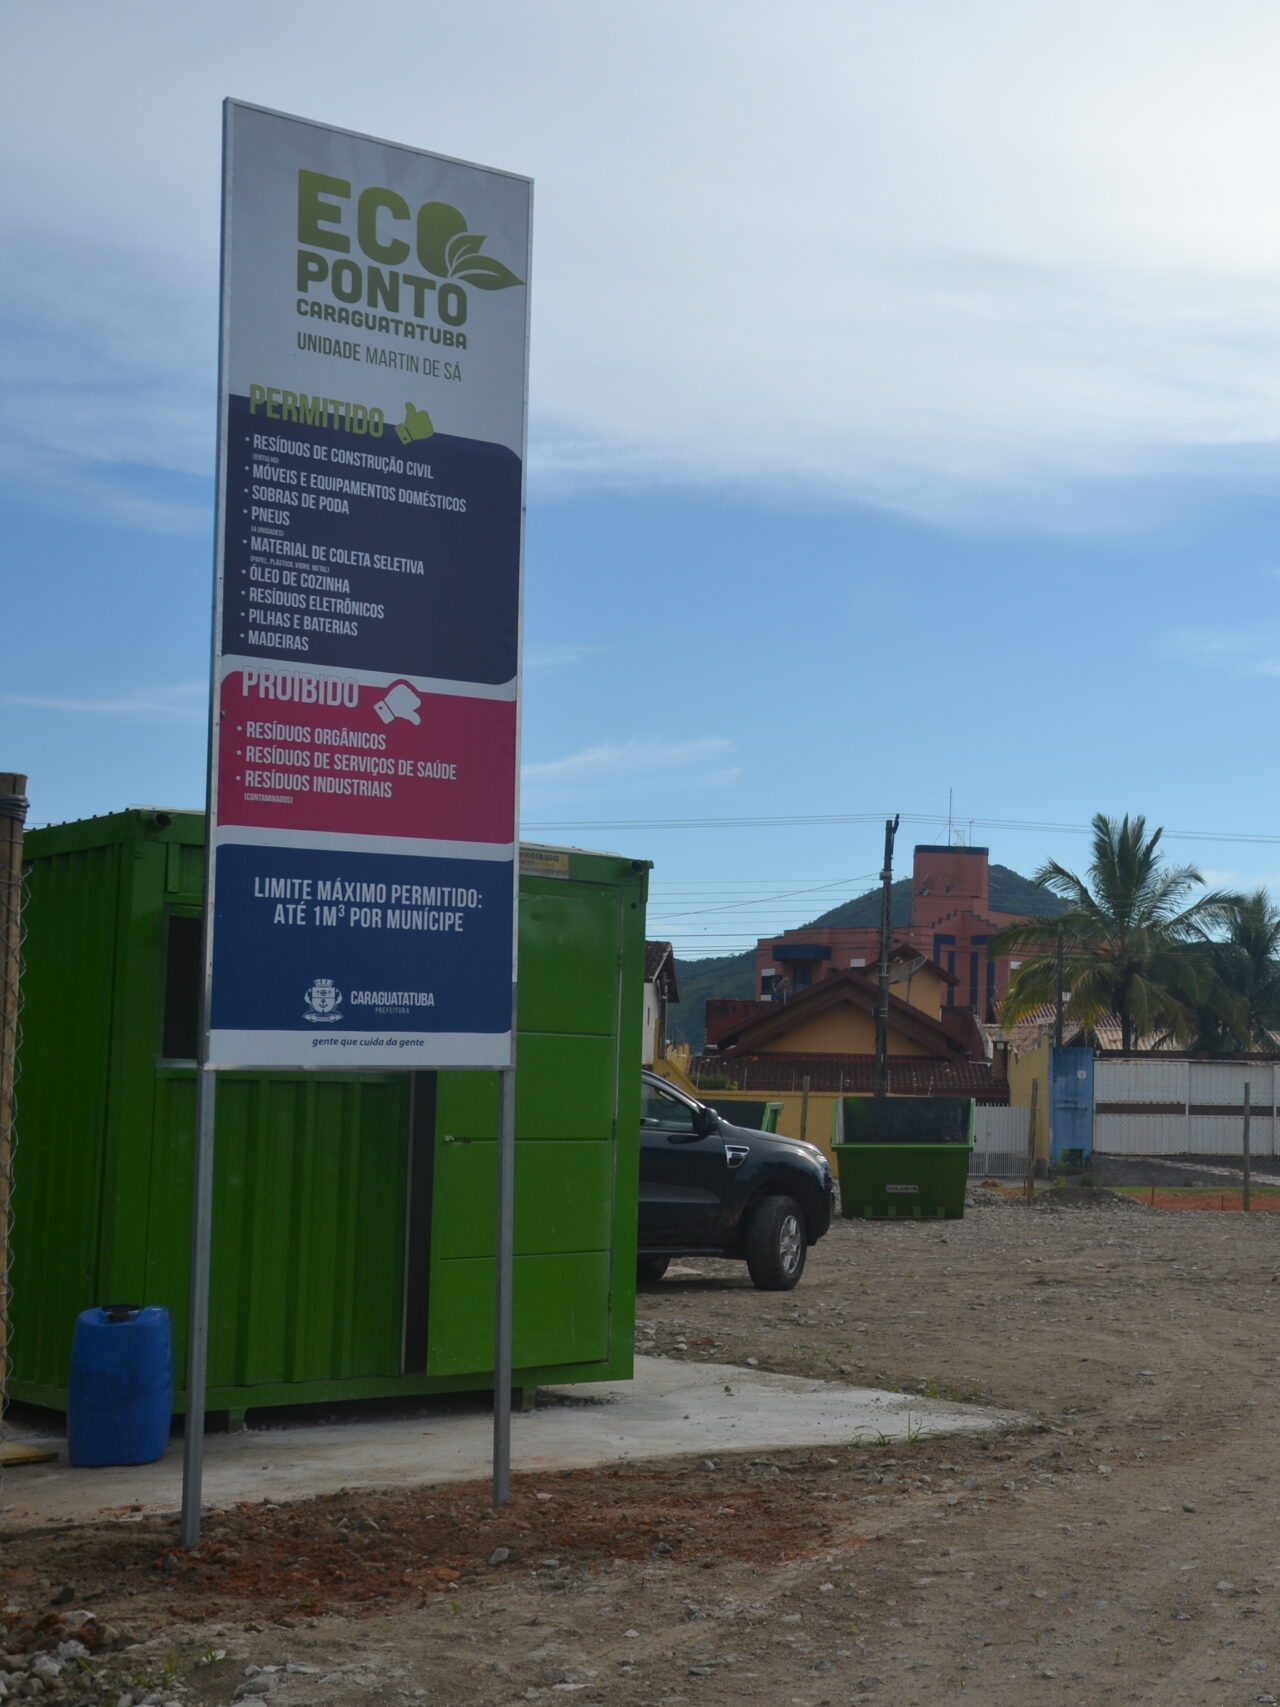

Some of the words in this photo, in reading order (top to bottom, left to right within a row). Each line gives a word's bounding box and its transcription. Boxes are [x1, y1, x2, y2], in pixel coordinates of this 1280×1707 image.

[298, 169, 468, 278] ECO
[297, 249, 467, 327] PONTO
[296, 298, 467, 350] CARAGUATATUBA
[297, 331, 361, 361] UNIDADE
[365, 346, 419, 374] MARTIN
[423, 358, 440, 378] DE
[444, 361, 462, 383] SÁ
[250, 383, 384, 438] PERMITIDO
[253, 434, 310, 458] RESÍDUOS
[313, 444, 328, 461] DE
[331, 447, 404, 474] CONSTRUÇÃO
[406, 461, 434, 479] CIVIL
[252, 485, 298, 507] SOBRAS
[301, 492, 316, 508] DE
[319, 496, 350, 514] PODA
[253, 463, 297, 485] MÓVEIS
[300, 472, 308, 486] E
[310, 474, 396, 501] EQUIPAMENTOS
[399, 488, 467, 513] DOMÉSTICOS
[251, 506, 290, 526] PNEUS
[251, 535, 309, 558] MATERIAL
[312, 545, 327, 561] DE
[329, 548, 371, 568] COLETA
[373, 553, 424, 575] SELETIVA
[250, 564, 279, 584] ÓLEO
[283, 570, 298, 586] DE
[300, 573, 350, 594] COZINHA
[249, 587, 306, 608] RESÍDUOS
[309, 593, 384, 618] ELETRÔNICOS
[249, 608, 290, 628] PILHAS
[294, 614, 301, 629] E
[303, 615, 358, 636] BATERIAS
[248, 630, 309, 651] MADEIRAS
[242, 665, 359, 708] PROIBIDO
[246, 721, 311, 743] RESÍDUOS
[314, 728, 386, 750] ORGÂNICOS
[246, 745, 310, 768] RESÍDUOS
[314, 752, 330, 769] DE
[333, 754, 395, 776] SERVIÇOS
[398, 759, 414, 776] DE
[417, 761, 457, 780] SAÚDE
[245, 769, 309, 792] RESÍDUOS
[313, 778, 392, 798] INDUSTRIAIS
[254, 876, 313, 900] LIMITE
[317, 878, 387, 904] MÁXIMO
[391, 884, 482, 909] PERMITIDO:
[273, 900, 306, 926] ATÉ
[350, 908, 382, 928] POR
[386, 907, 464, 932] MUNÍCIPE
[350, 991, 435, 1006] CARAGUATATUBA
[375, 1006, 410, 1014] PREFEITURA
[312, 1038, 339, 1047] gente
[340, 1038, 358, 1047] que
[359, 1037, 384, 1046] cuida
[386, 1038, 398, 1046] da
[399, 1039, 425, 1048] gente
